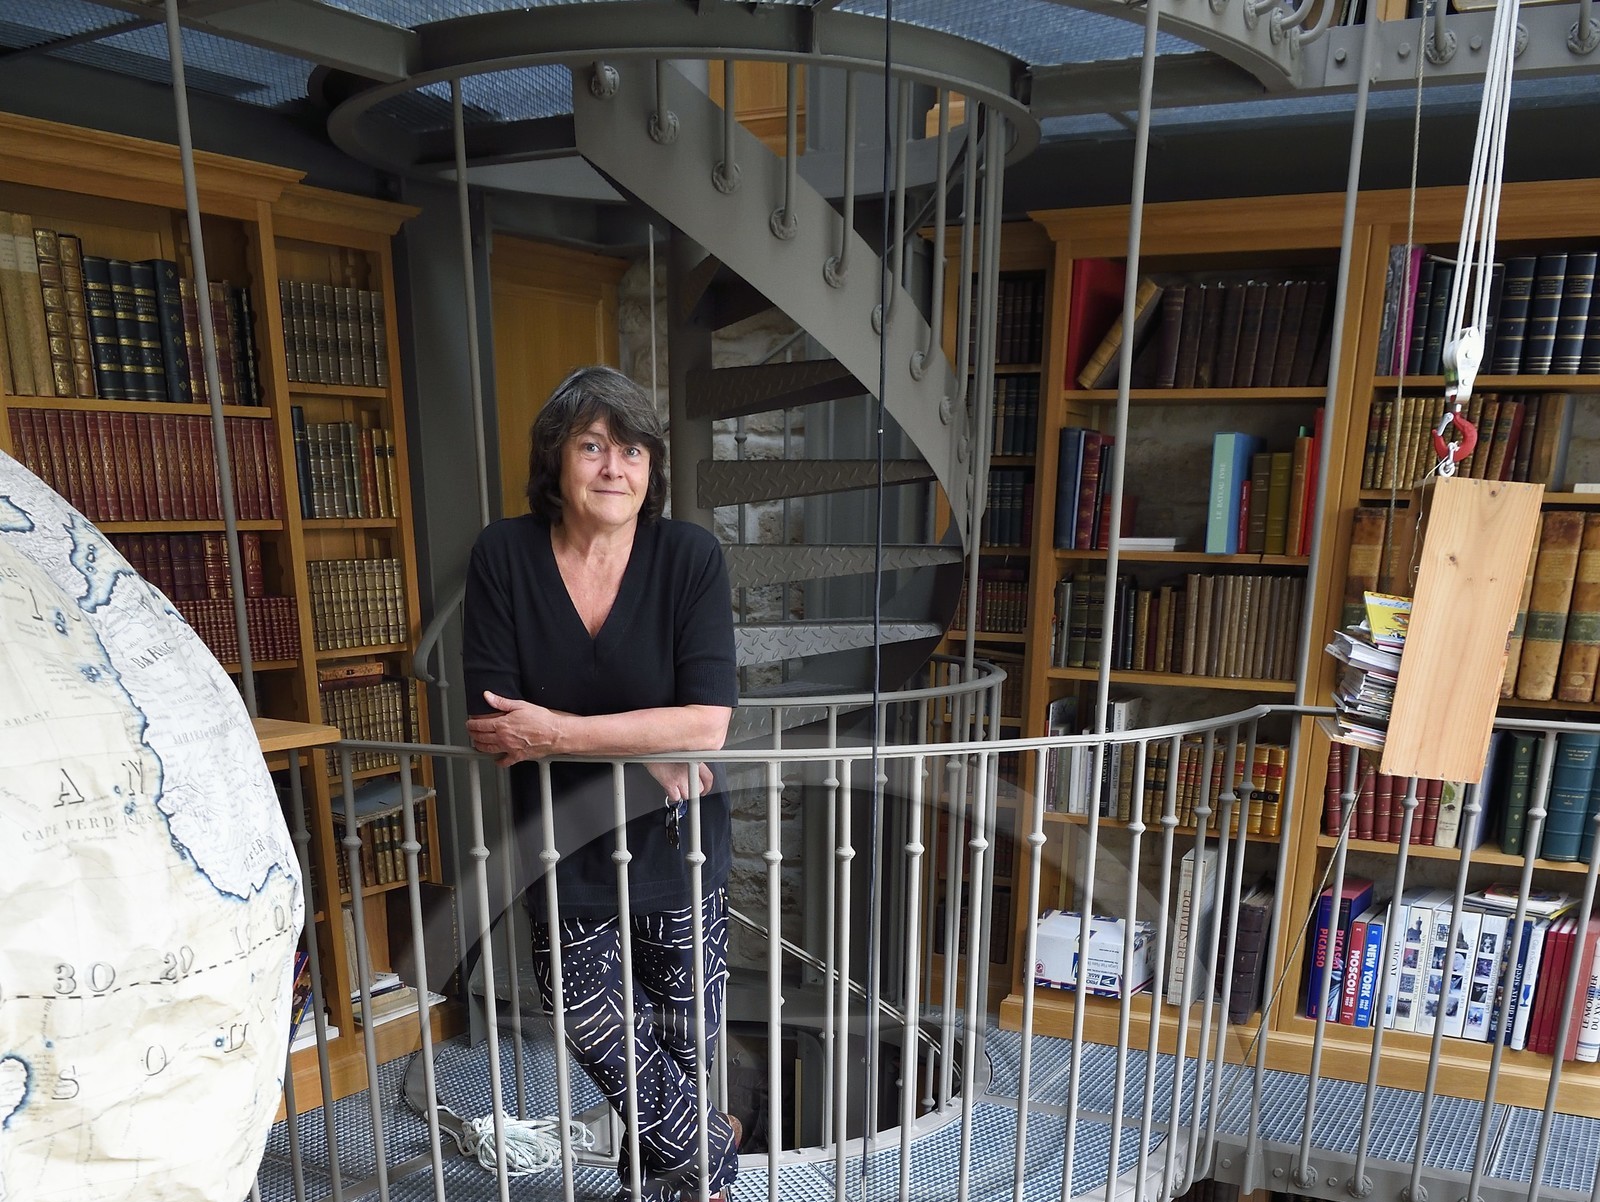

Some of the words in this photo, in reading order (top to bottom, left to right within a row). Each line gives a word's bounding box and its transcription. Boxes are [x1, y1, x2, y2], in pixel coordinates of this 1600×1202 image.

[1176, 889, 1194, 961] BESTIAIRE
[1316, 928, 1329, 968] PICASSO
[1332, 930, 1345, 969] PICASSO
[1366, 943, 1378, 969] NEW
[53, 962, 116, 995] 30
[1346, 950, 1361, 995] MOSCOU
[1361, 968, 1375, 998] YORK
[1509, 1004, 1516, 1015] du
[1584, 974, 1599, 1021] MOBILIER
[1581, 1020, 1589, 1029] LE
[1590, 1015, 1599, 1031] DU
